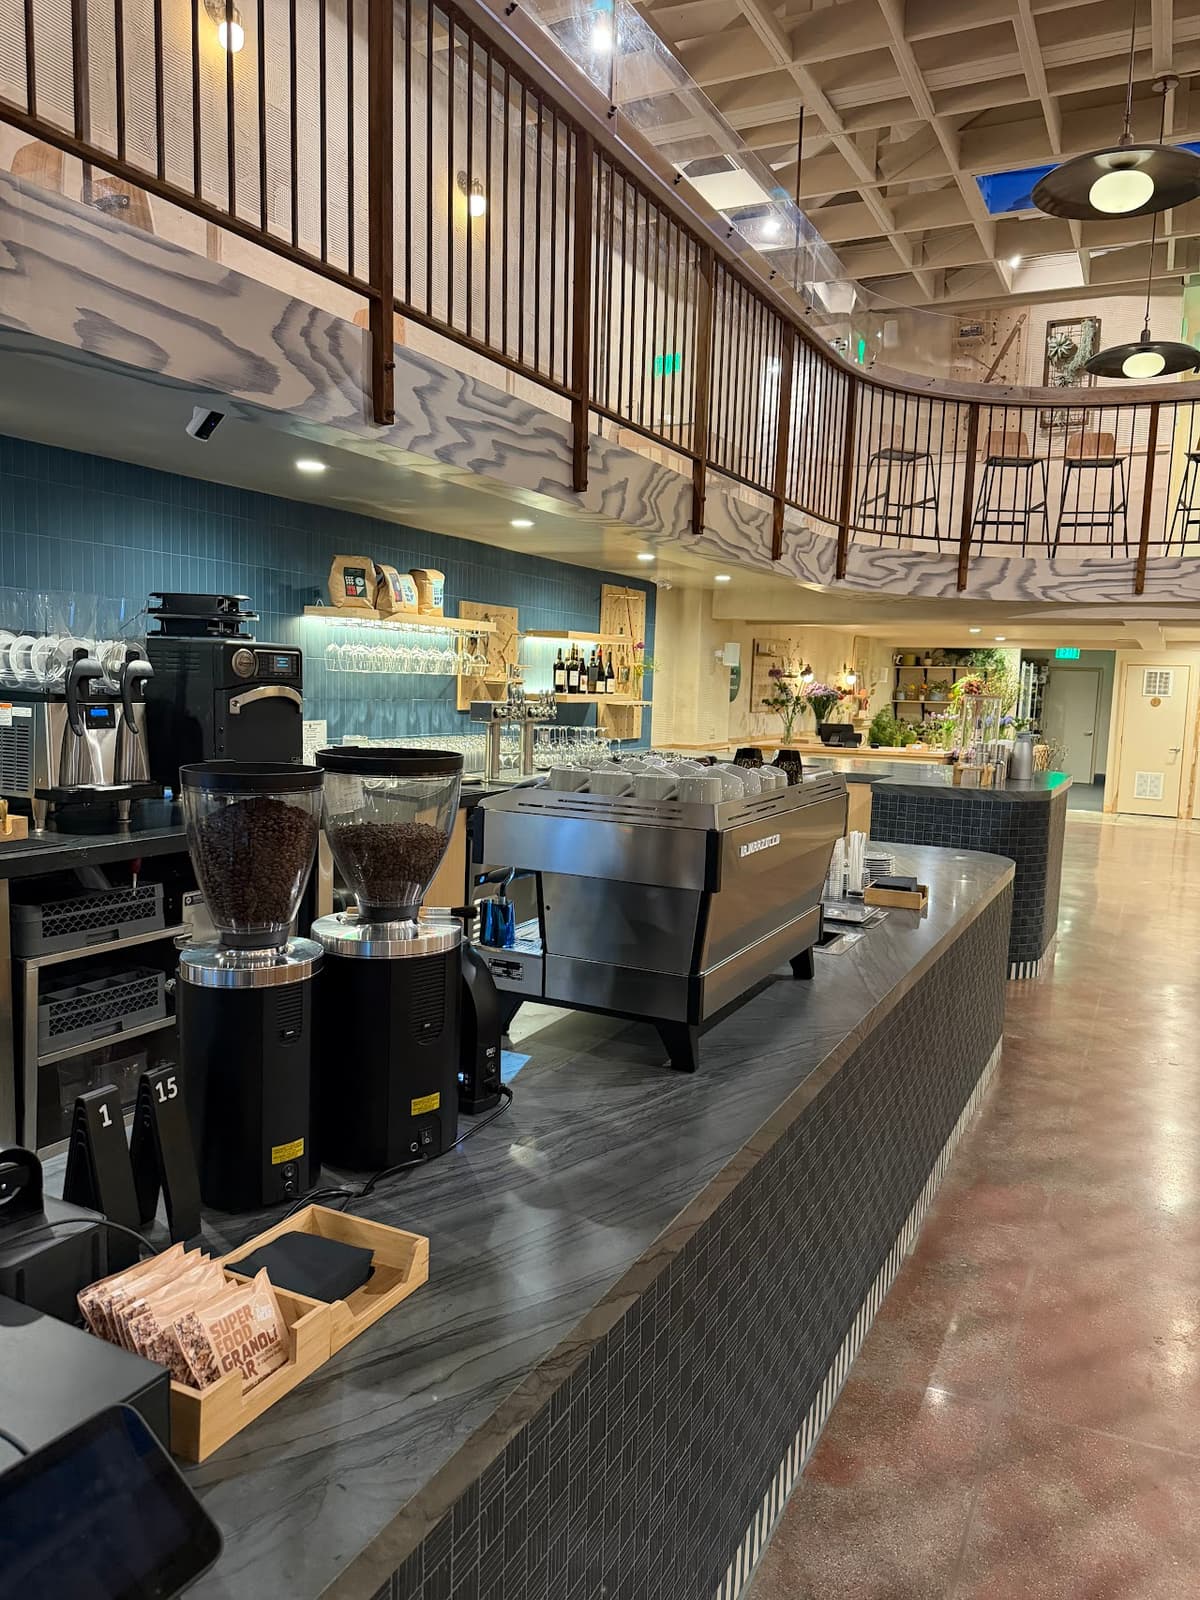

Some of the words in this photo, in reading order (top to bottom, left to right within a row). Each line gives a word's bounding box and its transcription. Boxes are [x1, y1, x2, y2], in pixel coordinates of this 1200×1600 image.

[155, 1076, 178, 1103] 15
[98, 1103, 113, 1128] 1
[209, 1304, 254, 1341] SUPER
[215, 1324, 253, 1357] FOOD
[239, 1359, 258, 1380] AR
